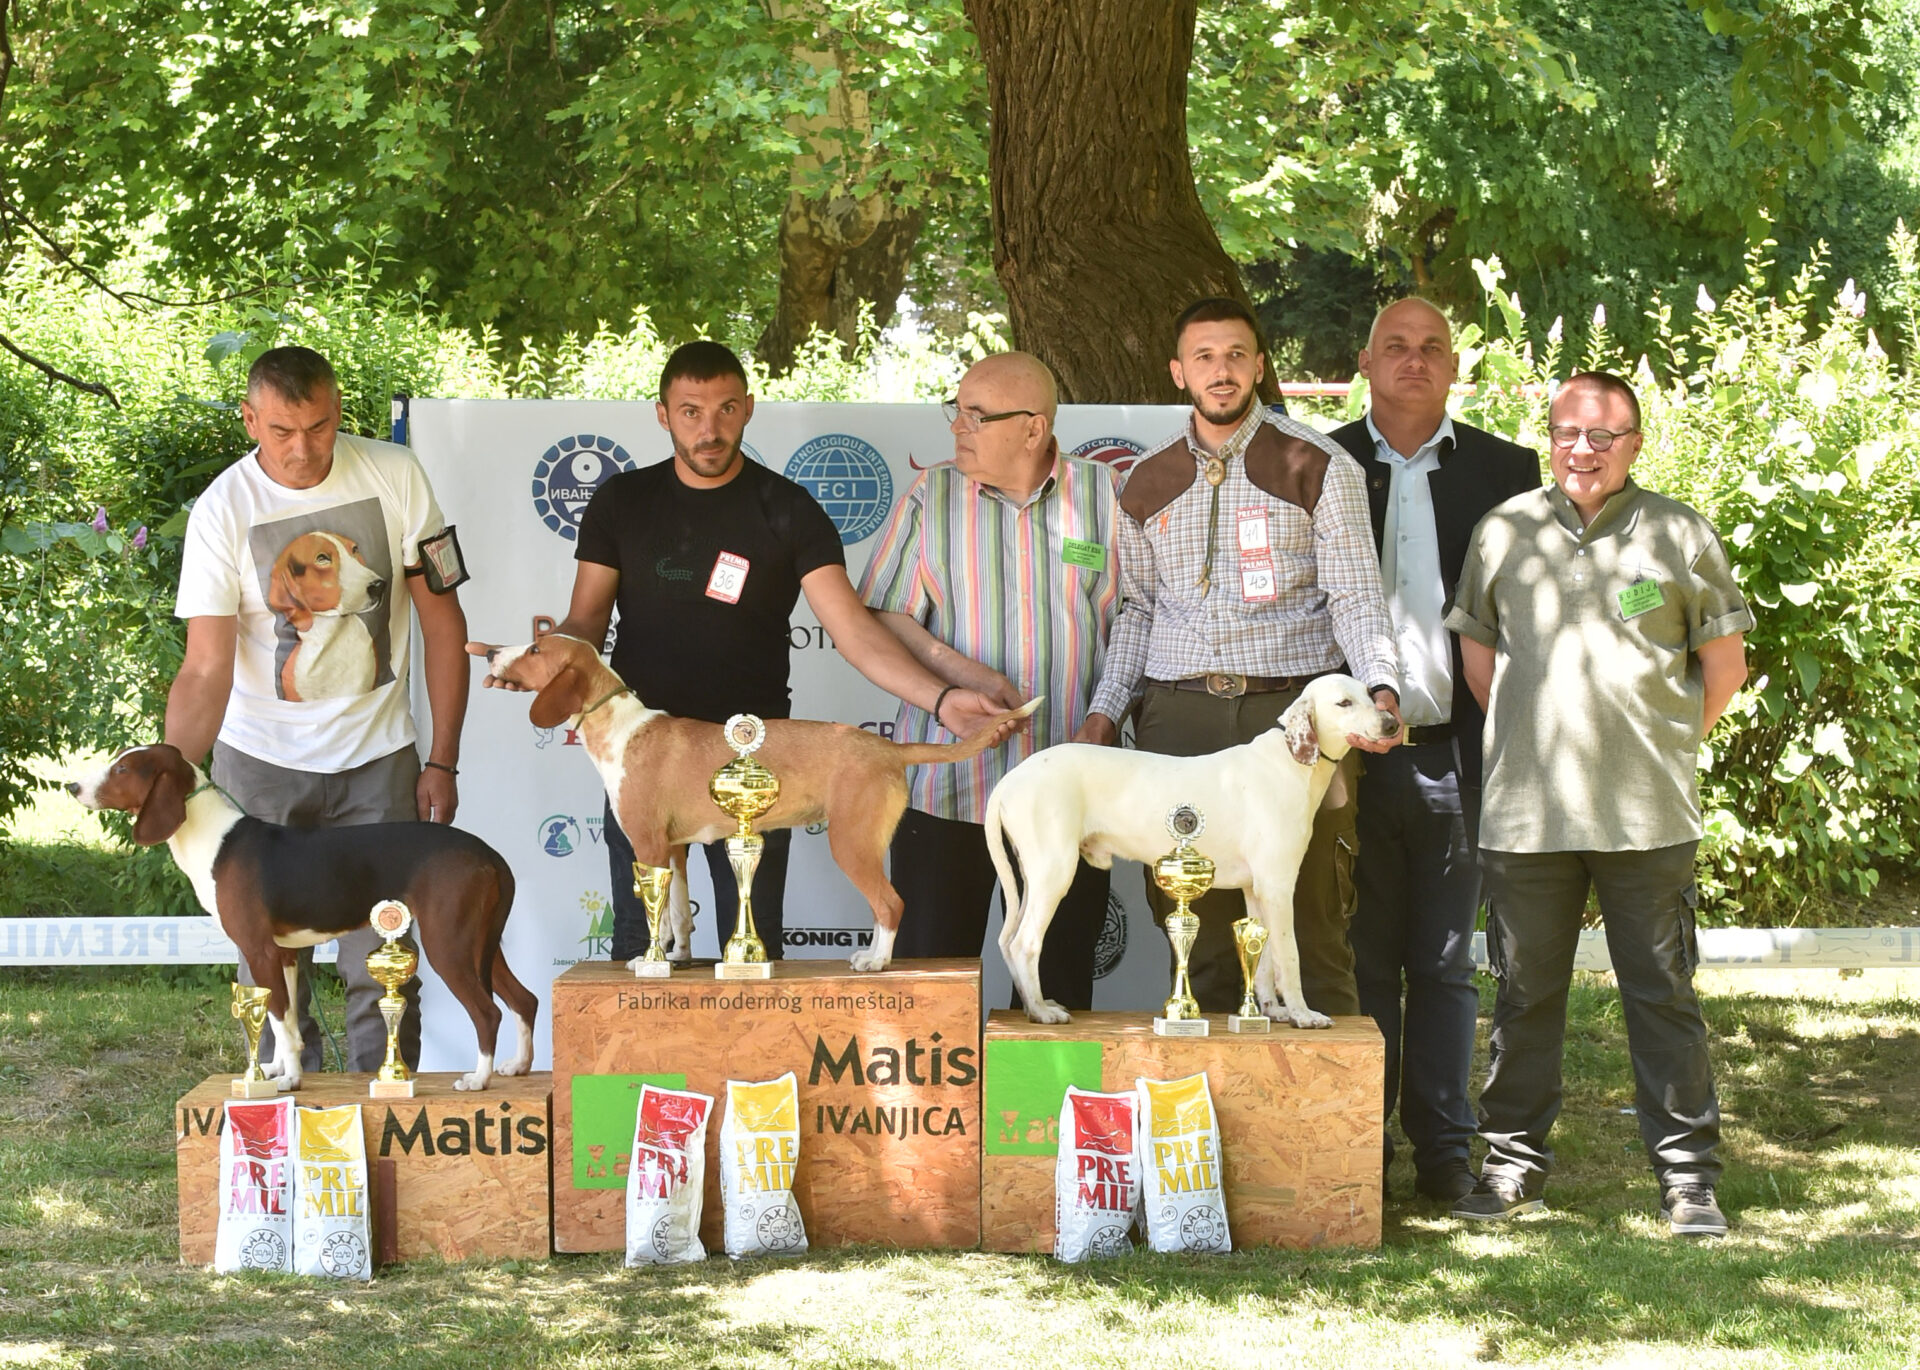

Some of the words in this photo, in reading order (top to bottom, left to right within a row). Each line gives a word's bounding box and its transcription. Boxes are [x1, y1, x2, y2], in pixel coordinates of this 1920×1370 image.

[817, 482, 857, 498] FCI
[617, 992, 690, 1010] Fabrika
[700, 993, 802, 1013] modernog
[811, 990, 915, 1014] nameštaja
[808, 1031, 978, 1086] Matis
[180, 1107, 225, 1136] IV
[378, 1101, 548, 1157] Matis
[816, 1105, 967, 1141] IVANJICA
[736, 1136, 797, 1166] PRE
[1154, 1135, 1215, 1169] PRE
[231, 1161, 288, 1188] PRE
[303, 1166, 364, 1191] PRE
[1076, 1154, 1134, 1185] PRE
[759, 1207, 790, 1233] MAXI
[1182, 1208, 1212, 1234] MAXI
[242, 1231, 274, 1255] MAXI
[322, 1233, 354, 1257] MAXI
